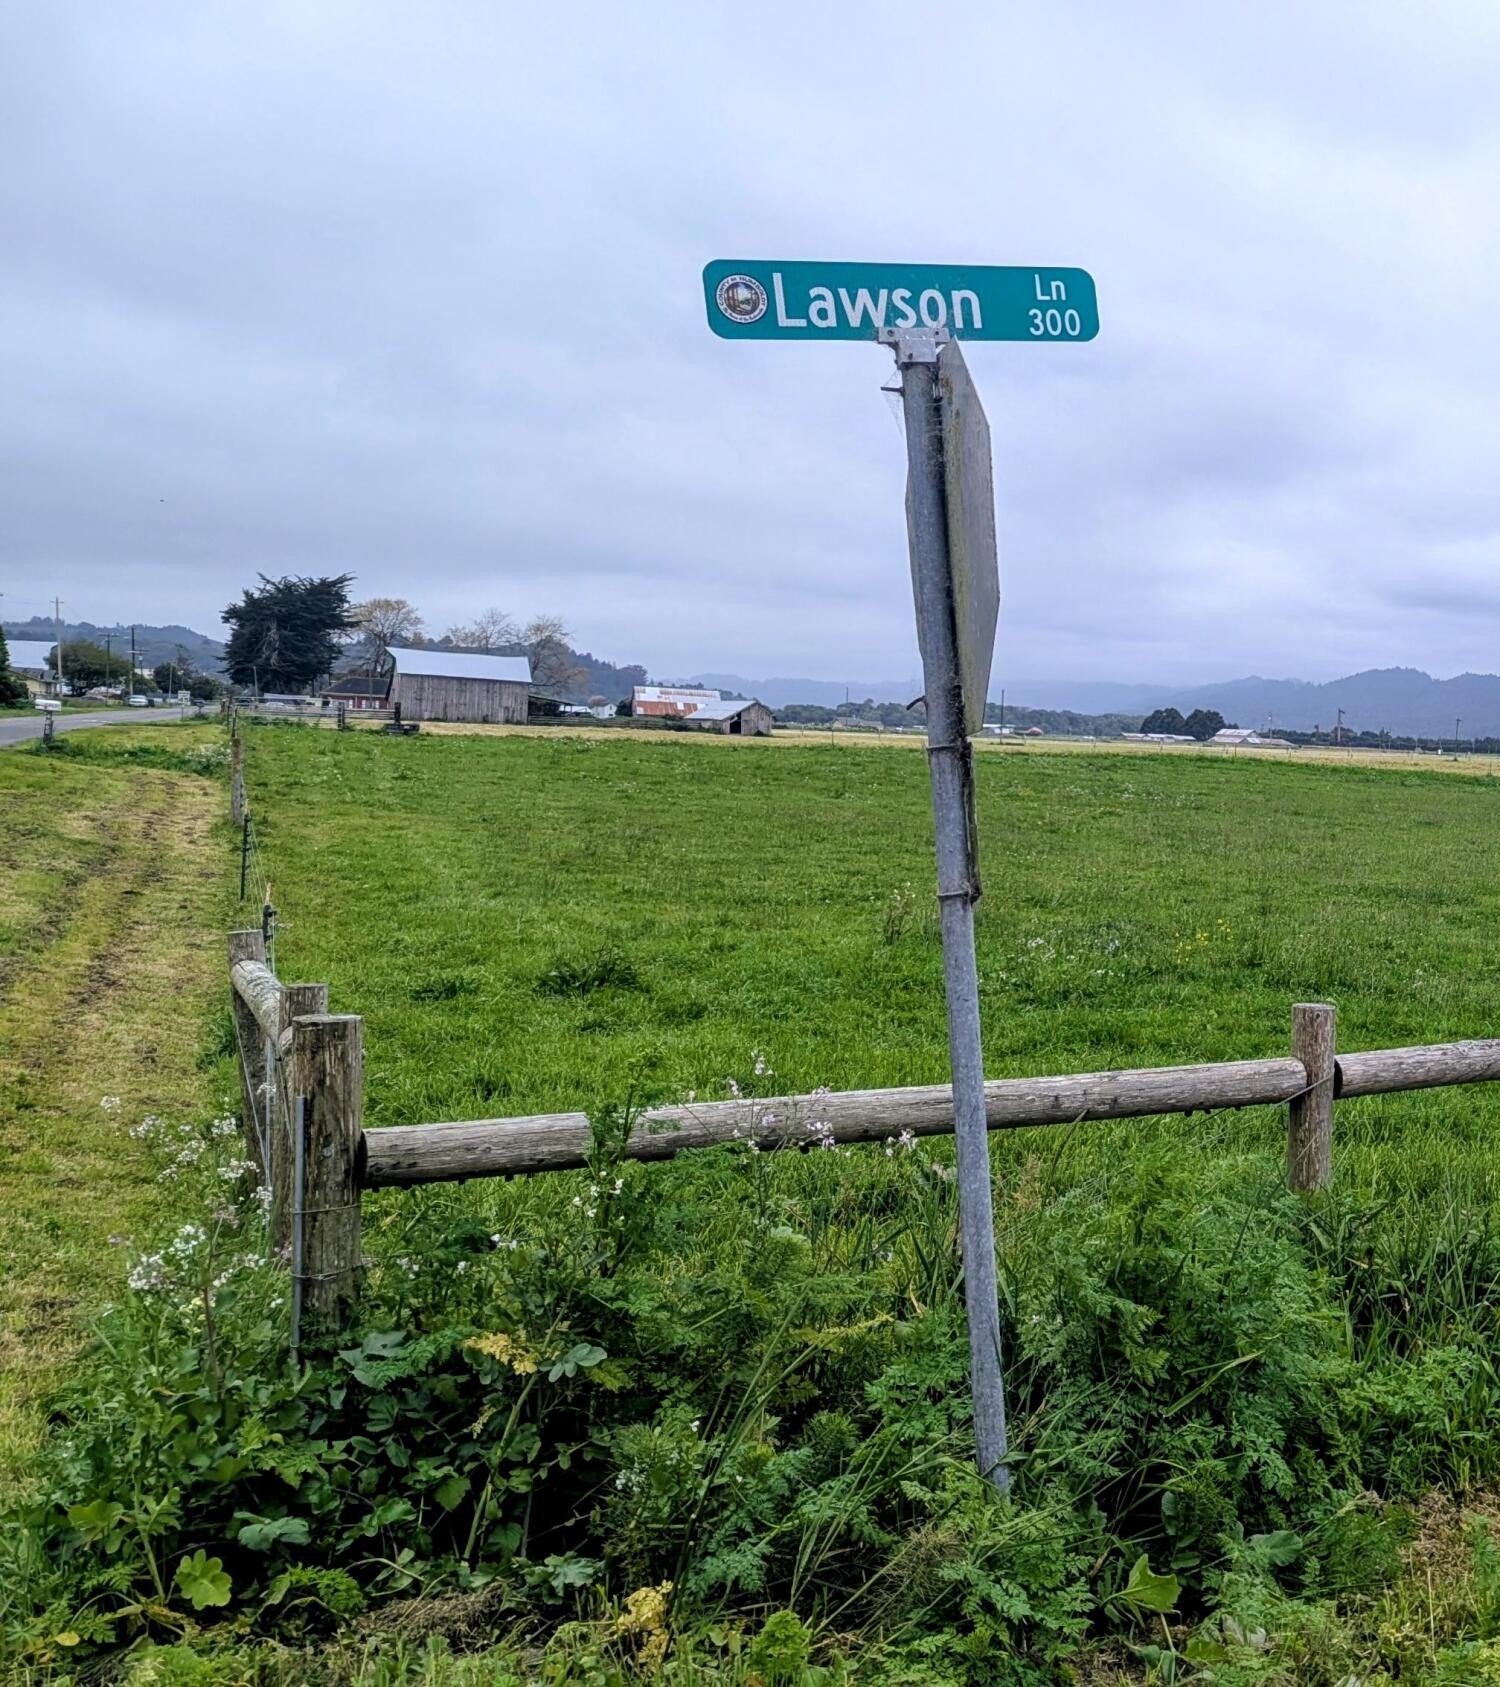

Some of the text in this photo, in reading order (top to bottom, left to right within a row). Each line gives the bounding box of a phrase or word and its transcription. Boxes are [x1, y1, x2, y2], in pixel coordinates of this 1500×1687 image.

[772, 272, 983, 329] Lawson
[1034, 274, 1066, 300] Ln
[1028, 309, 1080, 337] 300
